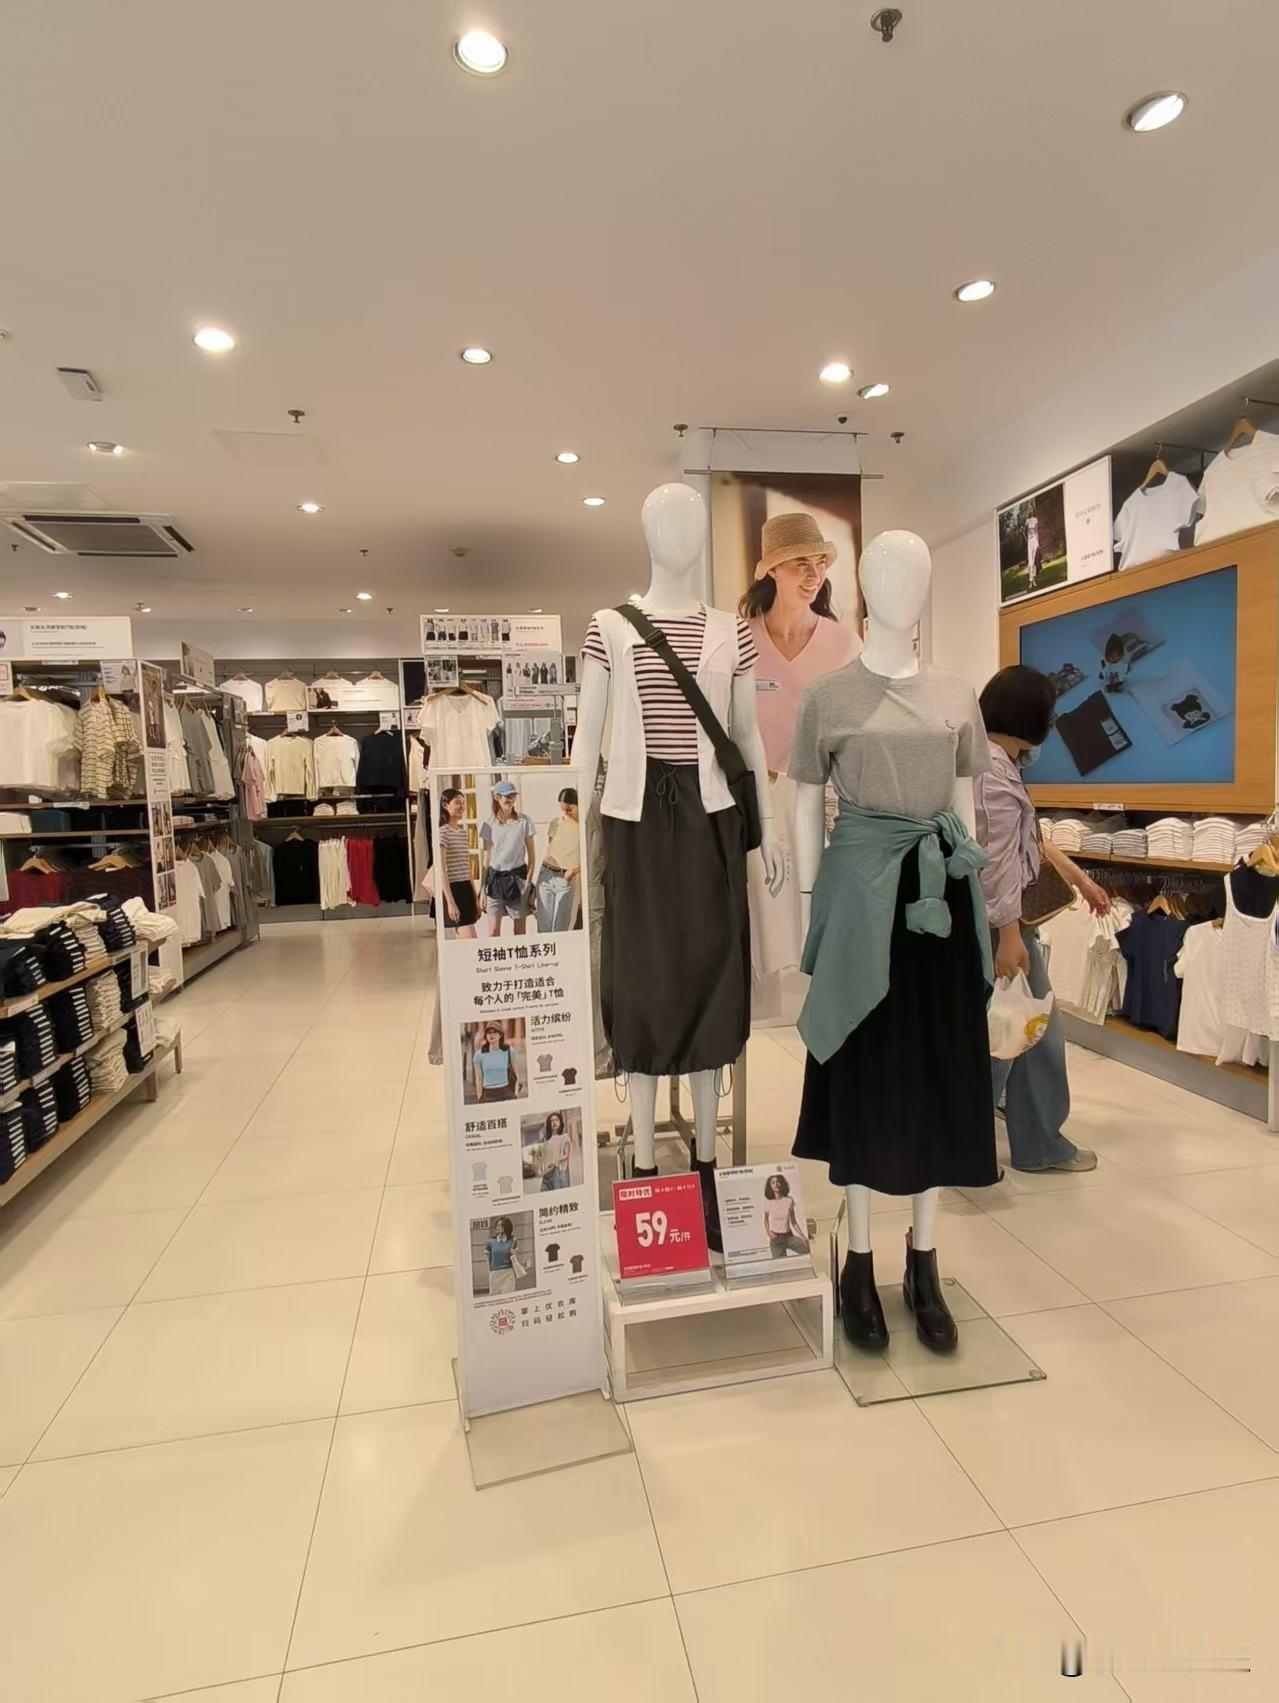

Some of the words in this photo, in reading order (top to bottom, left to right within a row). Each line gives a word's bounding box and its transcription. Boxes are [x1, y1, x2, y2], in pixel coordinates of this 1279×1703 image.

[477, 943, 557, 962] 短袖T恤系列
[481, 976, 555, 993] 致力于打造适合
[531, 1012, 572, 1026] 活力缤纷
[464, 1117, 508, 1133] 舒适百搭
[538, 1201, 579, 1218] 简约精致
